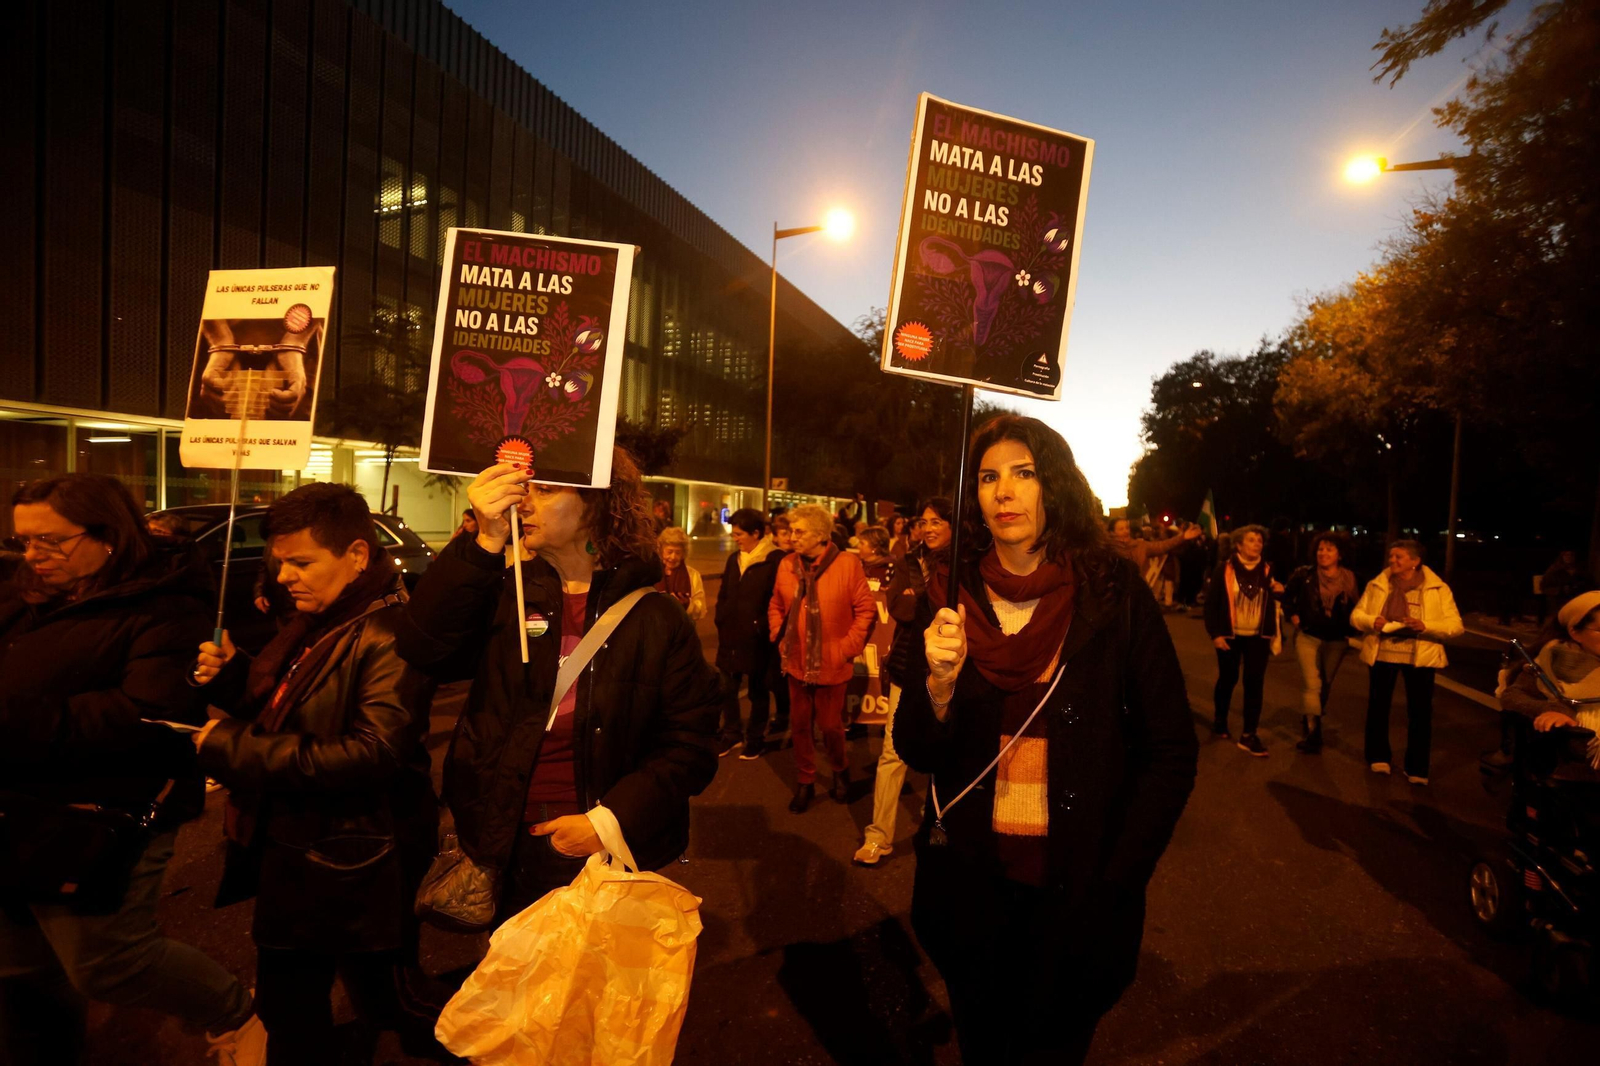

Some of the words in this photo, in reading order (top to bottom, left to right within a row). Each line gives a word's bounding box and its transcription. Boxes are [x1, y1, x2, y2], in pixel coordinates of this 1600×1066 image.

[934, 114, 954, 139] EL
[961, 120, 1070, 168] MACHISMO
[930, 140, 984, 172] MATA
[989, 155, 1002, 177] A
[1008, 159, 1043, 186] LAS
[926, 165, 1020, 206] MUJERES
[924, 189, 952, 214] NO
[955, 198, 968, 219] A
[974, 201, 1009, 227] LAS
[921, 214, 1020, 249] IDENTIDADES
[463, 241, 484, 262] EL
[490, 244, 601, 275] MACHISMO
[257, 284, 292, 292] PULSERAS
[460, 264, 514, 289] MATA
[518, 272, 531, 290] A
[537, 273, 573, 294] LAS
[458, 287, 548, 315] MUJERES
[455, 309, 482, 329] NO
[486, 313, 498, 331] A
[504, 314, 538, 335] LAS
[453, 330, 550, 355] IDENTIDADES
